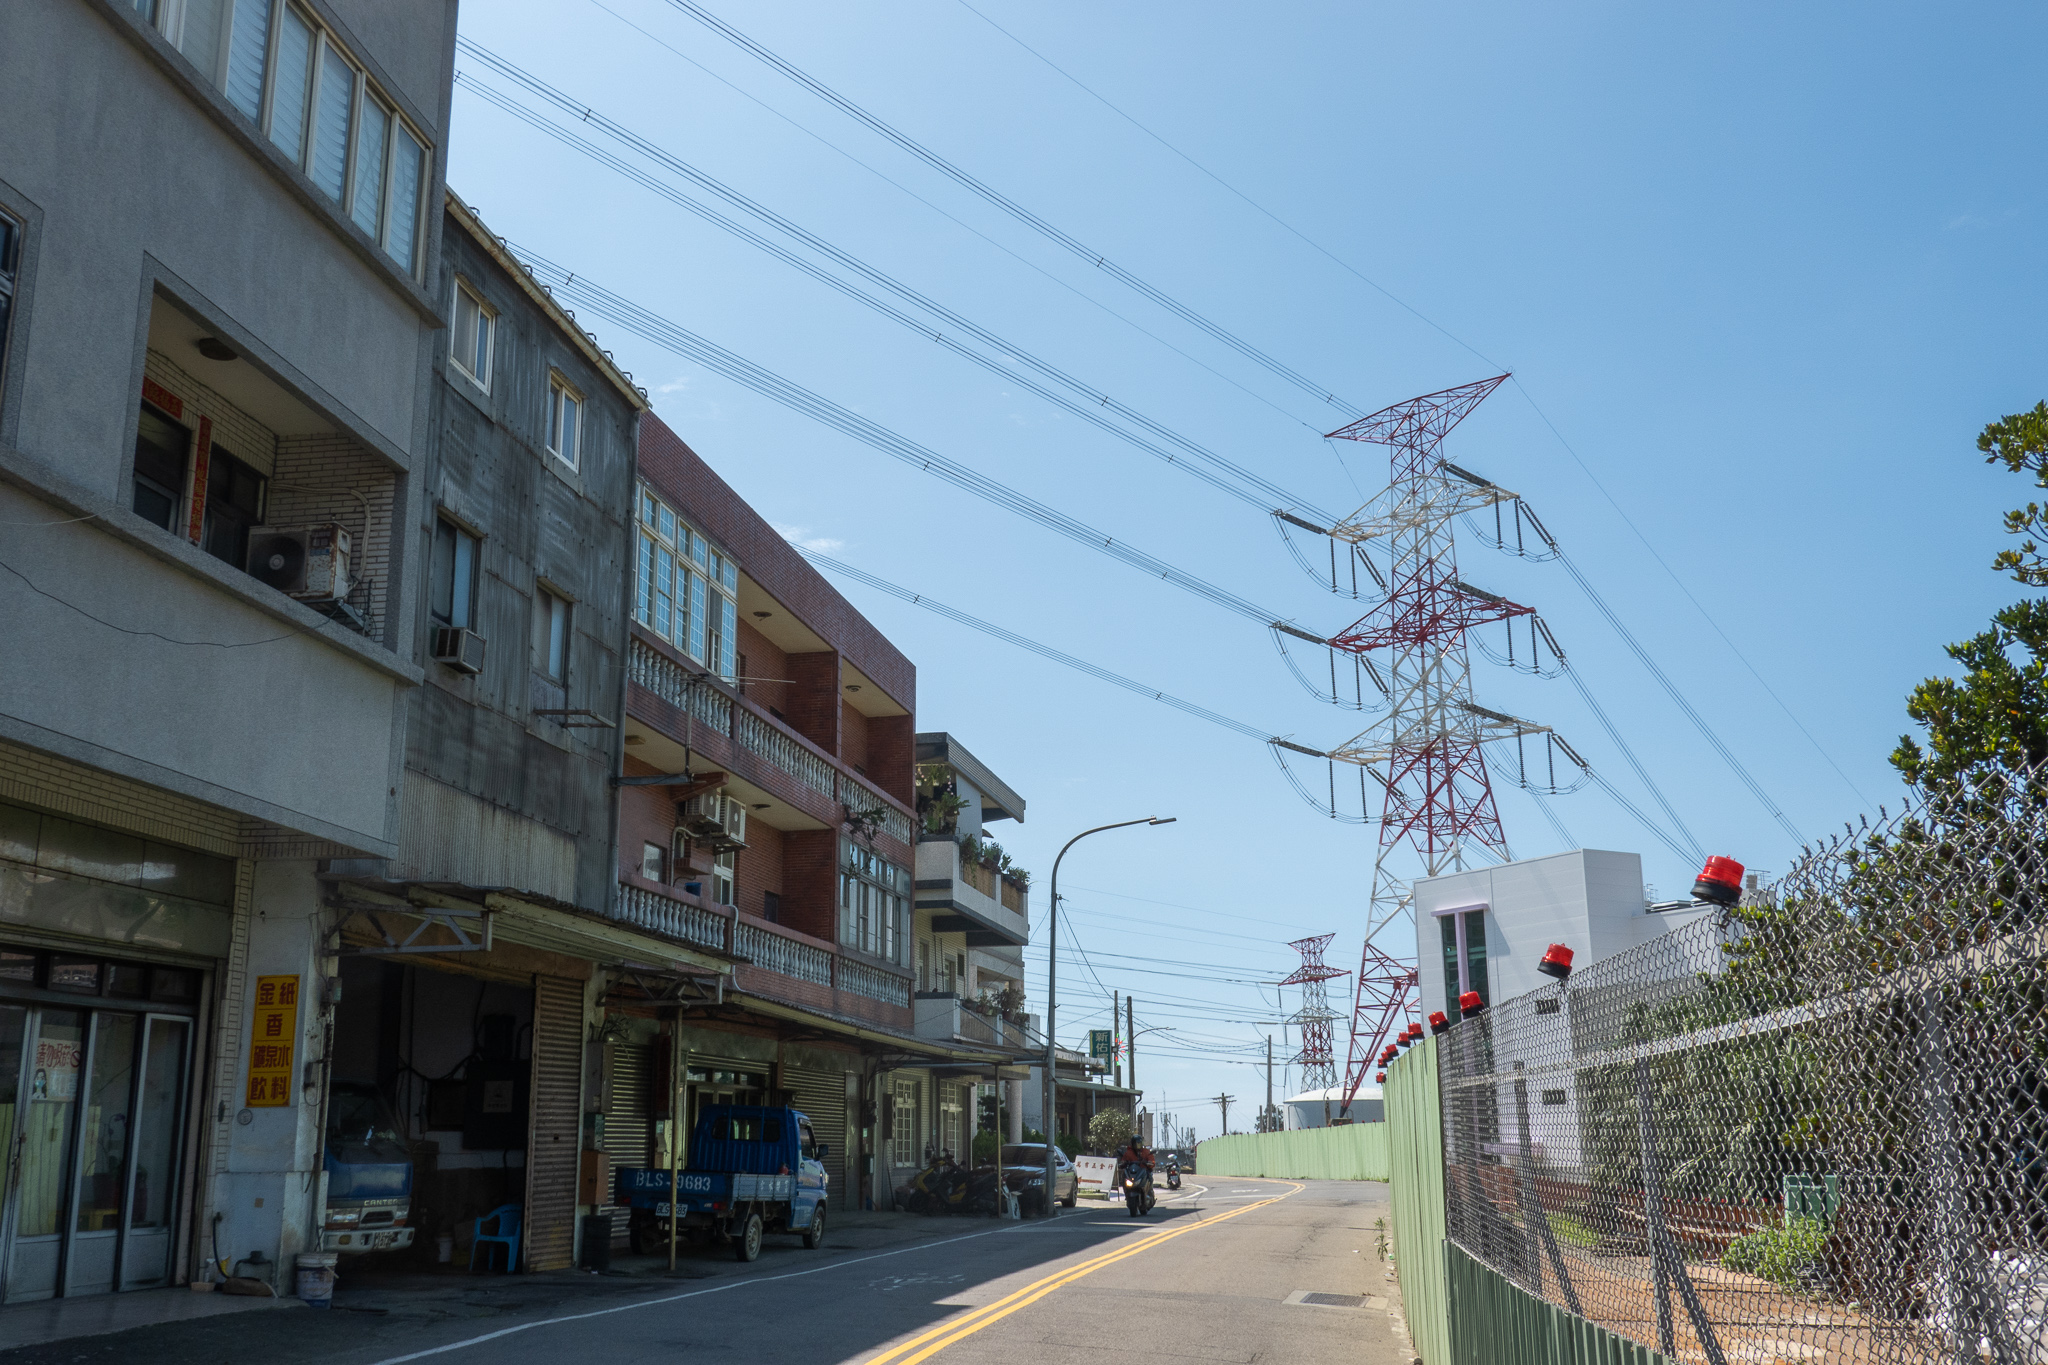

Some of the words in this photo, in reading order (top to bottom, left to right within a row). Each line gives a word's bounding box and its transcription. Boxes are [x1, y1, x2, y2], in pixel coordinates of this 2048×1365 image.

[258, 982, 295, 1006] 金紙
[266, 1013, 283, 1036] 香
[253, 1045, 290, 1068] 礦泉水
[250, 1076, 287, 1100] 飲料
